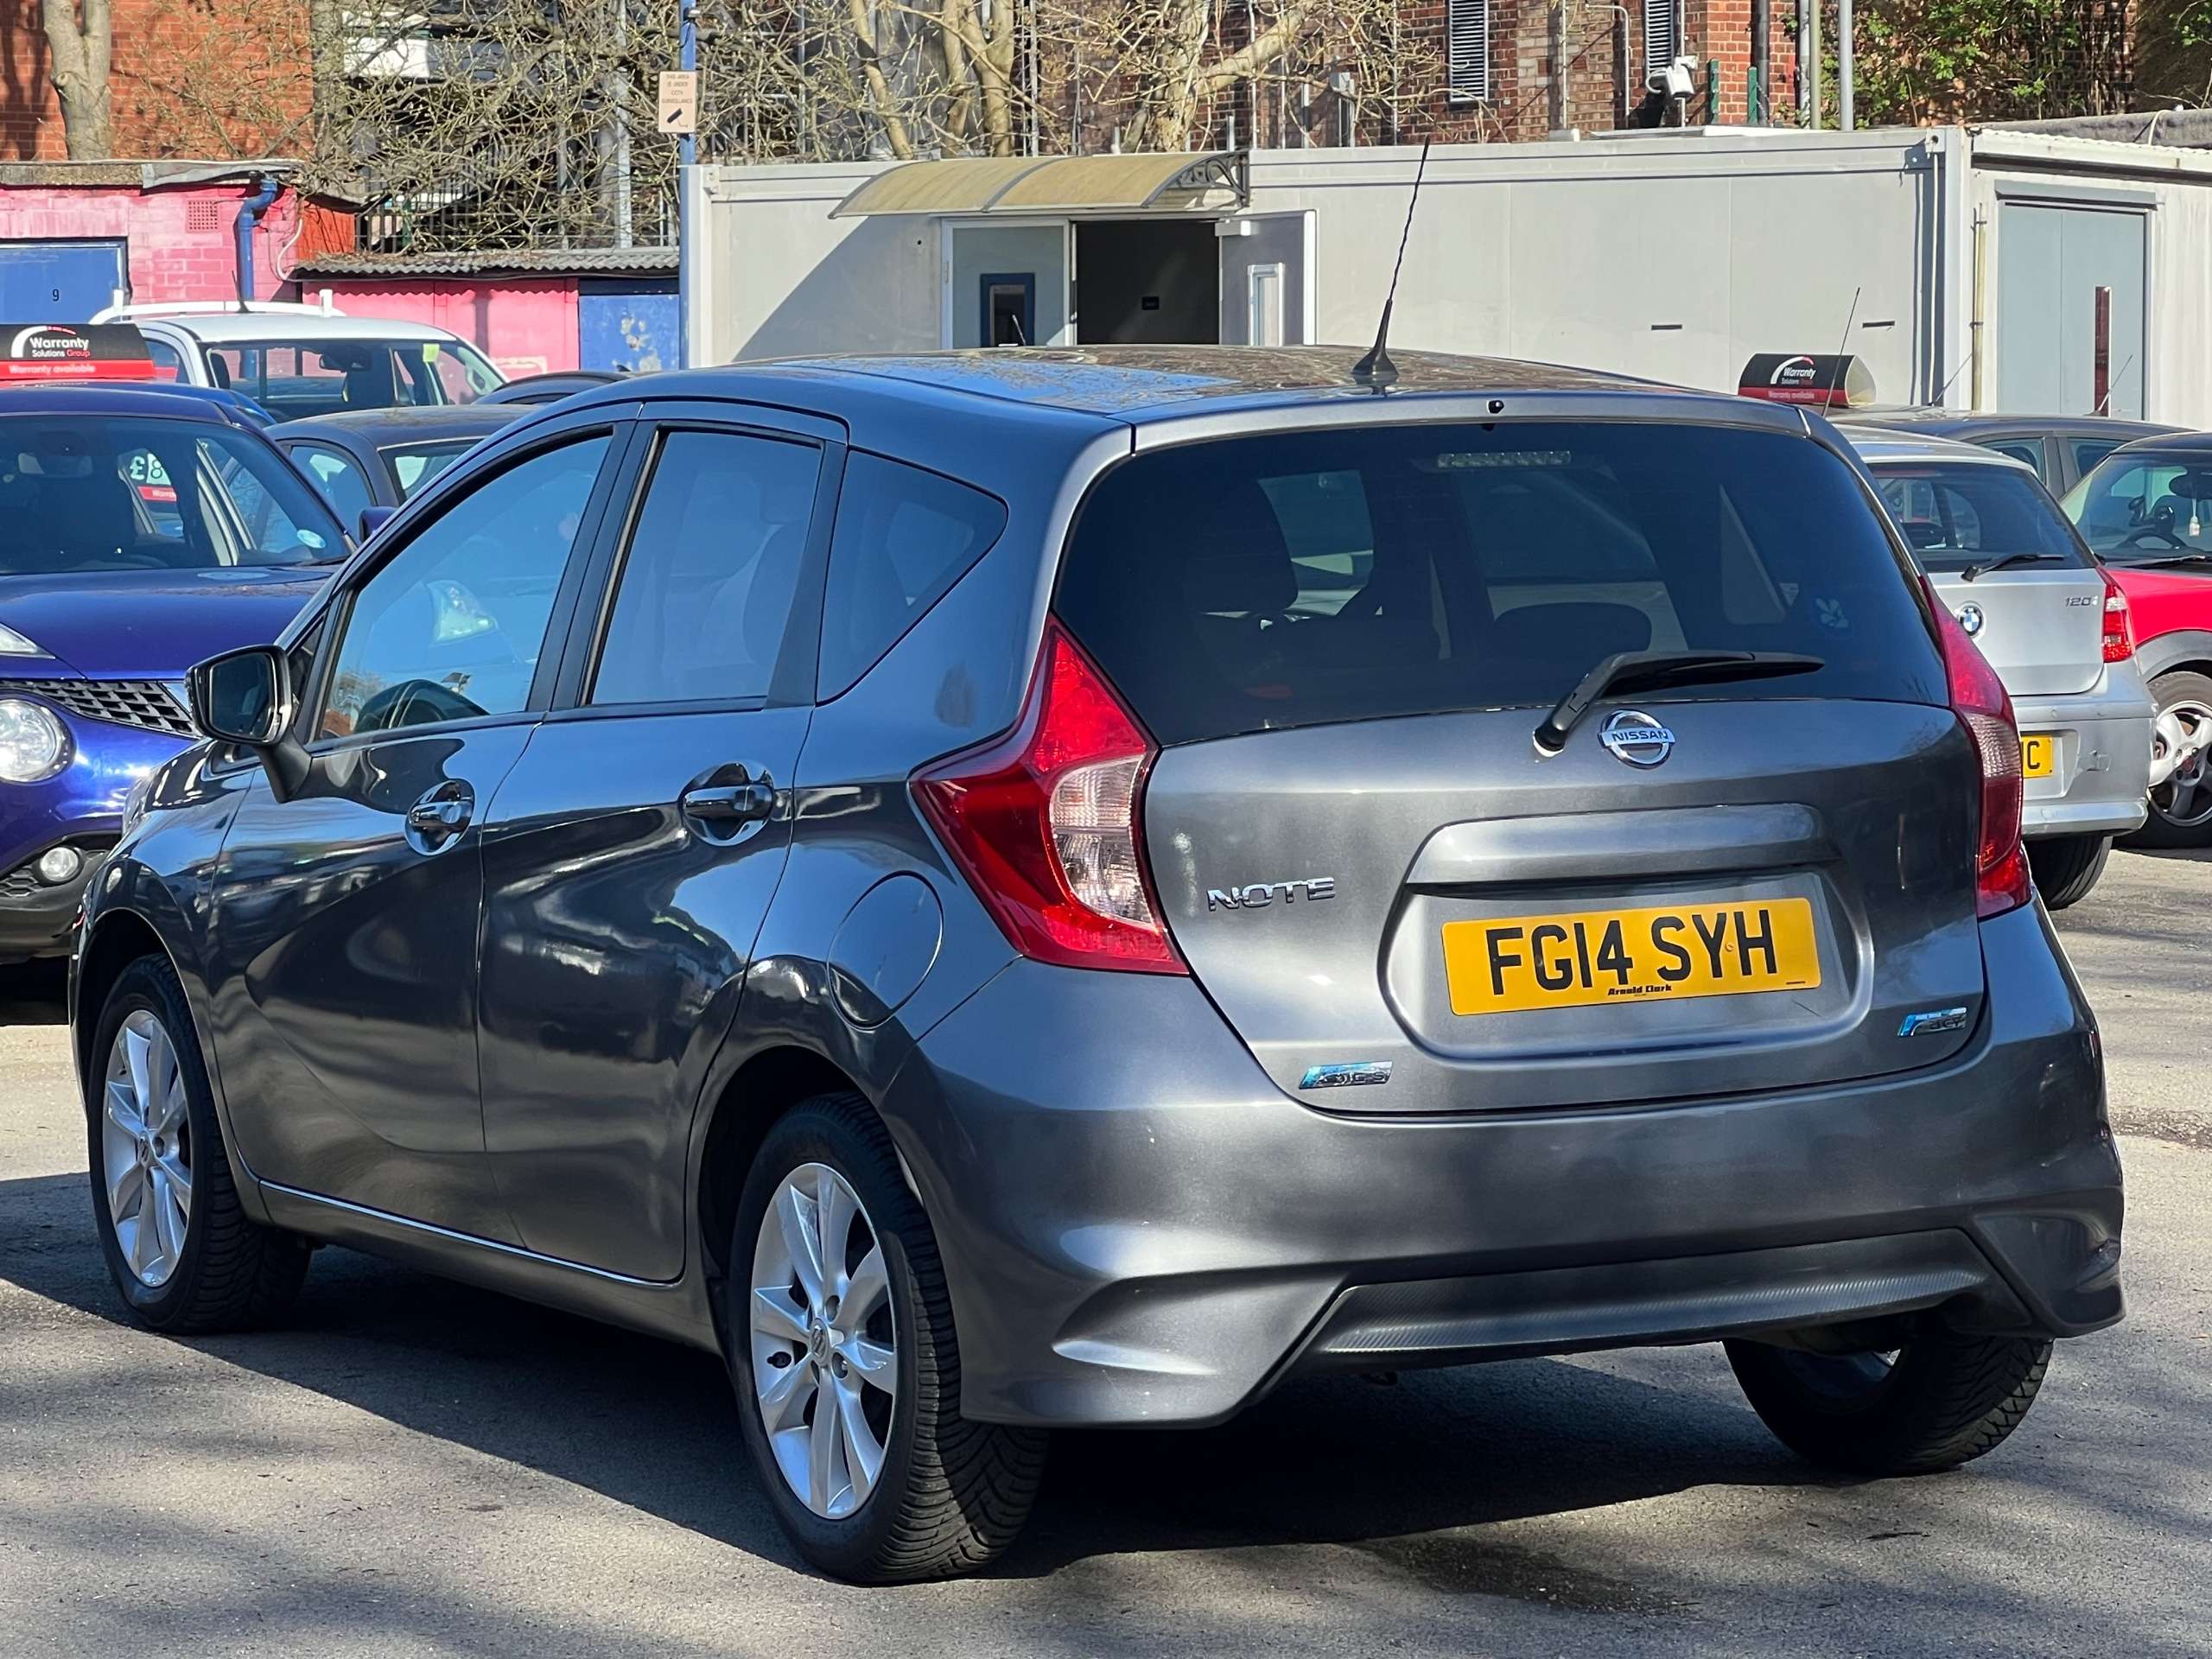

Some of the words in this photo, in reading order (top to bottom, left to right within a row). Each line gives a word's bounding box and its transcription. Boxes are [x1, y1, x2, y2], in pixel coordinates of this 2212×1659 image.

[53, 289, 60, 302] 9
[29, 337, 89, 351] Warranty
[32, 349, 65, 358] Solutions
[67, 349, 91, 359] Group
[9, 365, 52, 375] Warranty
[53, 363, 96, 373] available
[1783, 367, 1816, 379] Warranty
[1611, 730, 1669, 742] NISSAN
[2021, 741, 2041, 770] C
[1207, 877, 1335, 911] NOTE
[1485, 919, 1633, 995] FG14
[1651, 909, 1777, 982] SYH
[1608, 986, 1643, 995] Arnold
[1645, 984, 1672, 993] Clark
